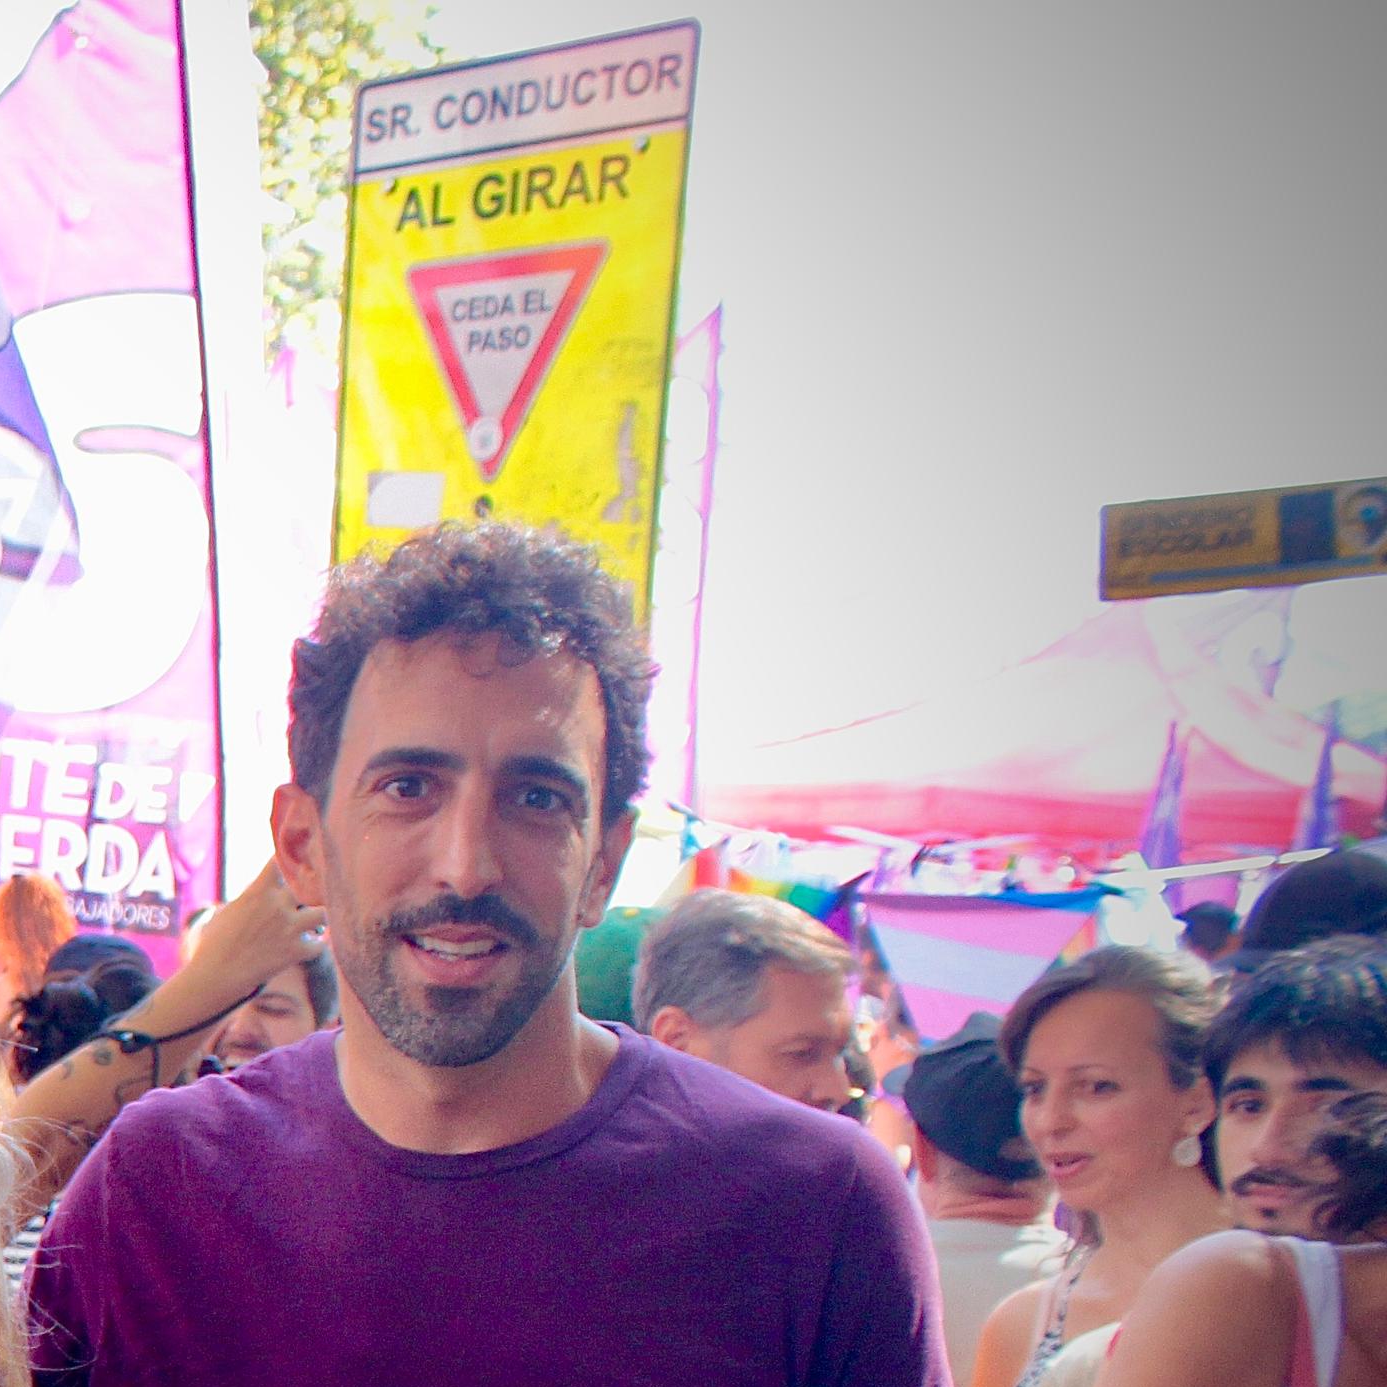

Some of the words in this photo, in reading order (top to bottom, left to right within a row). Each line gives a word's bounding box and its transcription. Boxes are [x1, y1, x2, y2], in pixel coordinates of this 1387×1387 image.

[364, 103, 420, 145] SR.
[433, 52, 683, 131] CONDUCTOR
[395, 182, 456, 233] AL
[472, 153, 632, 223] GIRAR
[451, 292, 518, 323] CEDA
[522, 288, 554, 314] EL
[467, 326, 532, 353] PASO
[93, 762, 174, 824] DE
